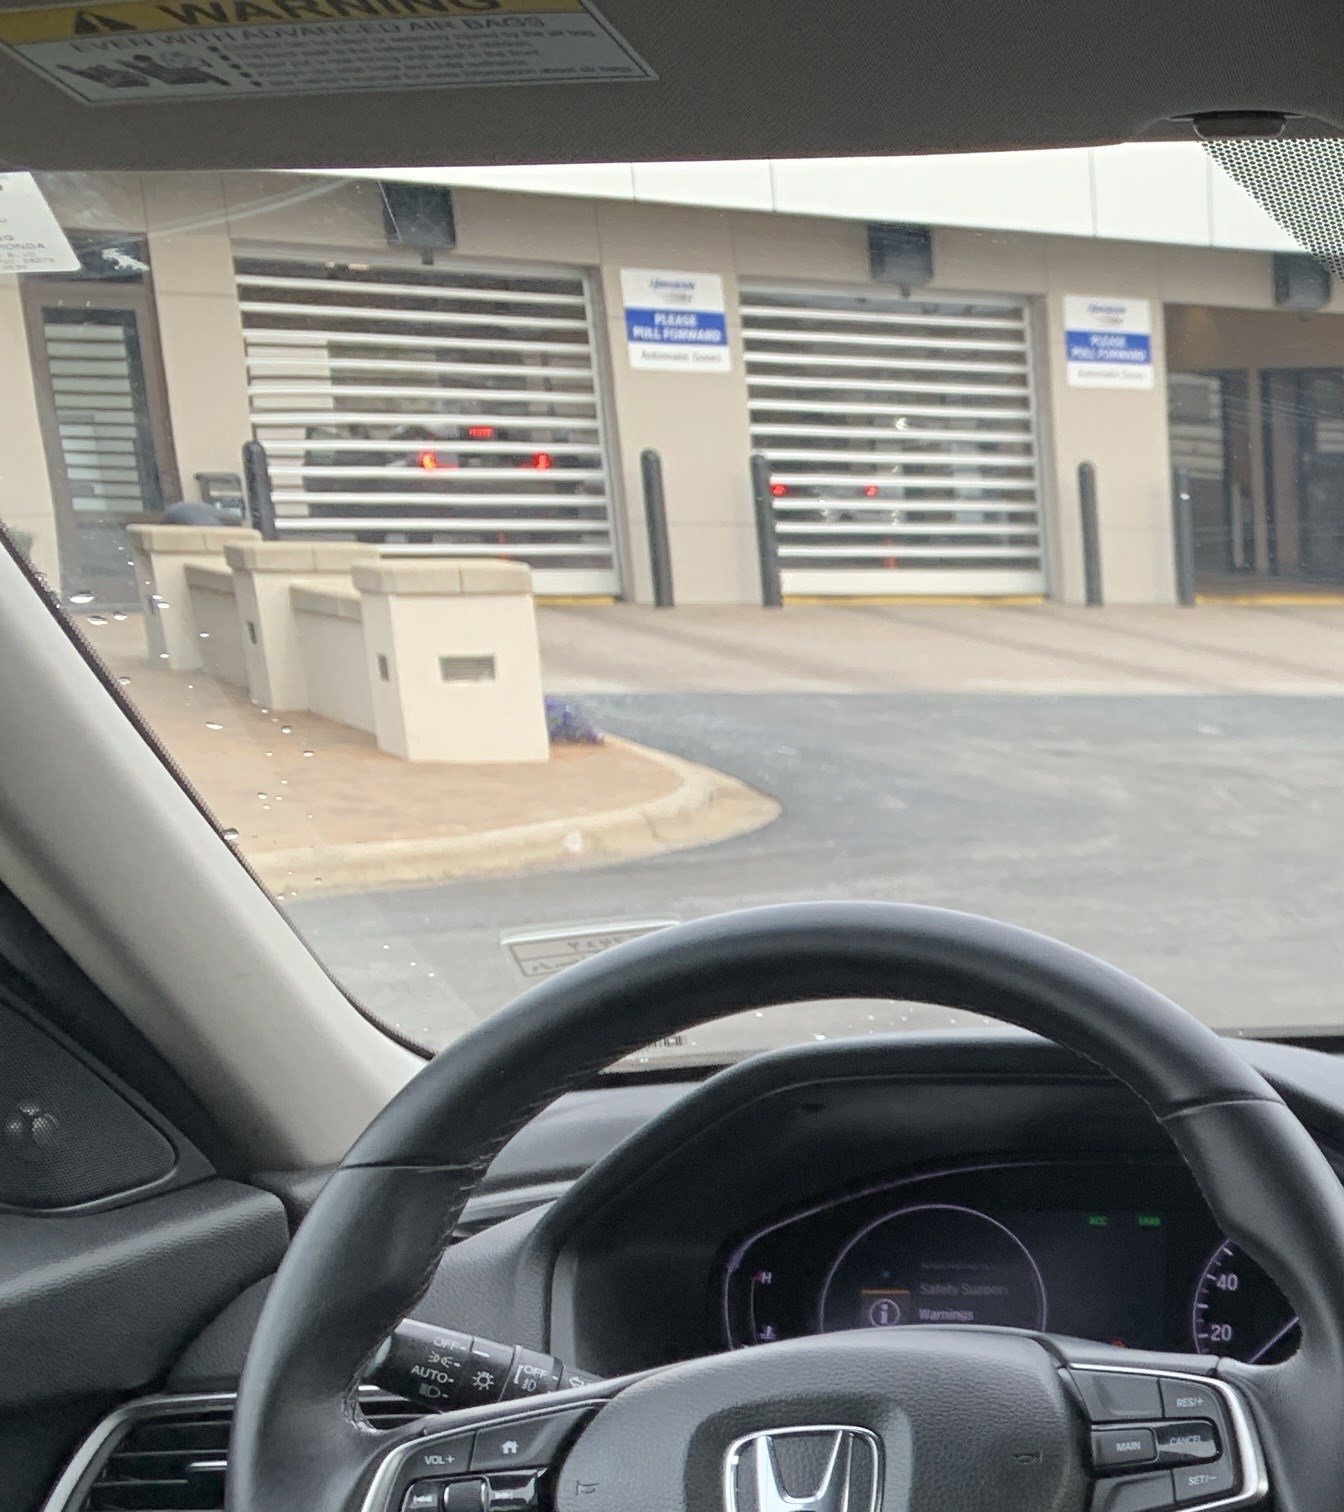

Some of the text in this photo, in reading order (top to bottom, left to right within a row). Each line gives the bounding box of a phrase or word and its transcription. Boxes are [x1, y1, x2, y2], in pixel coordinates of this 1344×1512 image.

[243, 20, 401, 39] ADVANCED
[410, 19, 455, 31] AIR
[463, 16, 546, 29] BAGS
[654, 312, 698, 326] PLEASE
[632, 326, 722, 342] PULL FORWARD
[1217, 1275, 1238, 1291] 40
[917, 1309, 975, 1322] Warnings
[1210, 1325, 1232, 1342] 20
[434, 1339, 461, 1350] OFF
[411, 1365, 448, 1383] AUTO
[524, 1366, 548, 1379] OFF
[1116, 1441, 1142, 1452] MAIN
[1170, 1435, 1202, 1446] CANCEL
